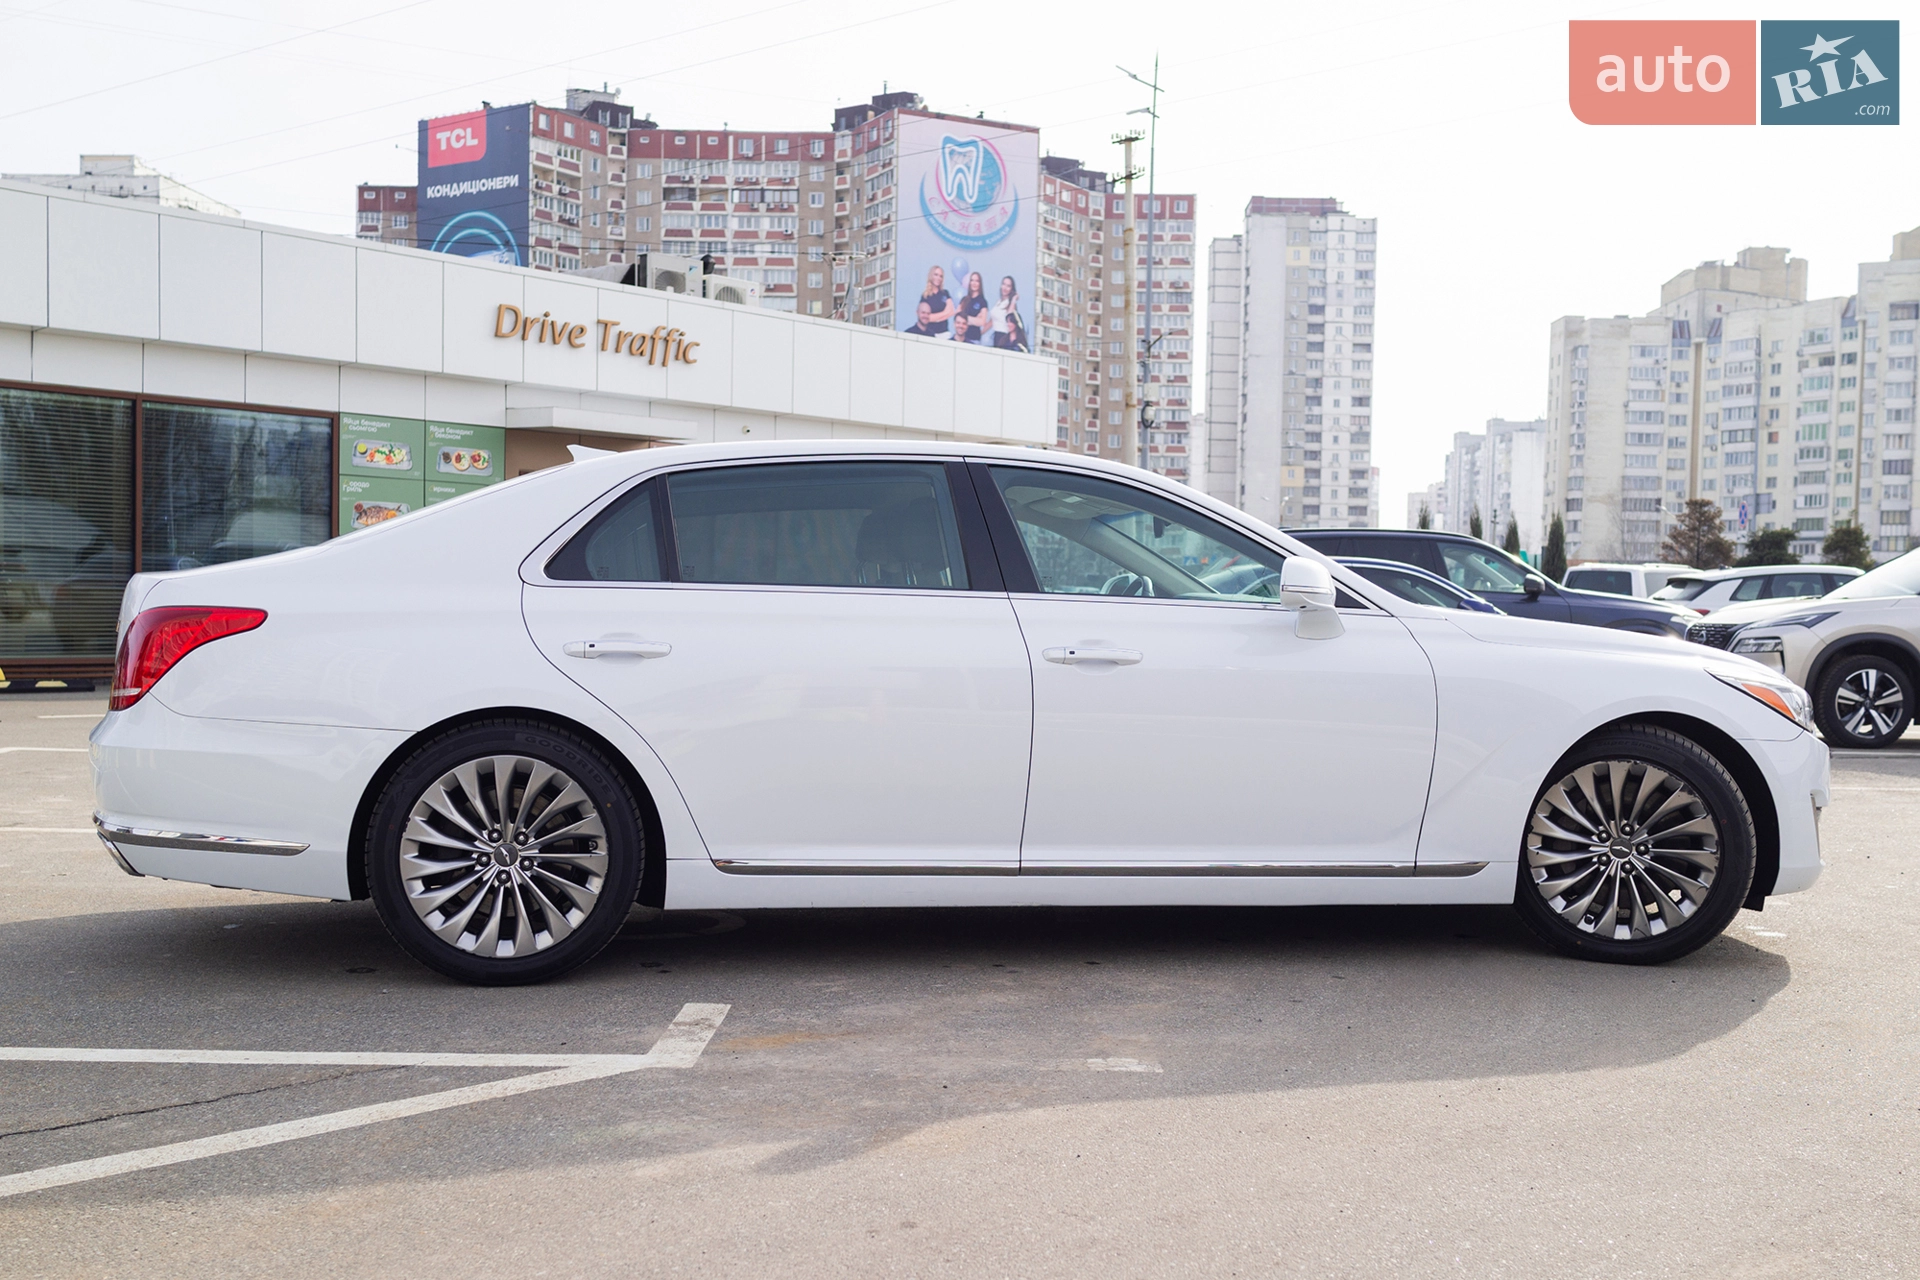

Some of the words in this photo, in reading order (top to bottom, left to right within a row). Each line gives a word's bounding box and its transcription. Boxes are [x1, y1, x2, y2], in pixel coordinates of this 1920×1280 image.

[435, 127, 479, 151] TCL
[426, 174, 519, 200] КОНДИЦІОНЕРИ
[495, 303, 588, 349] Drive
[597, 319, 702, 367] Traffic
[525, 736, 612, 794] GOODRIDE
